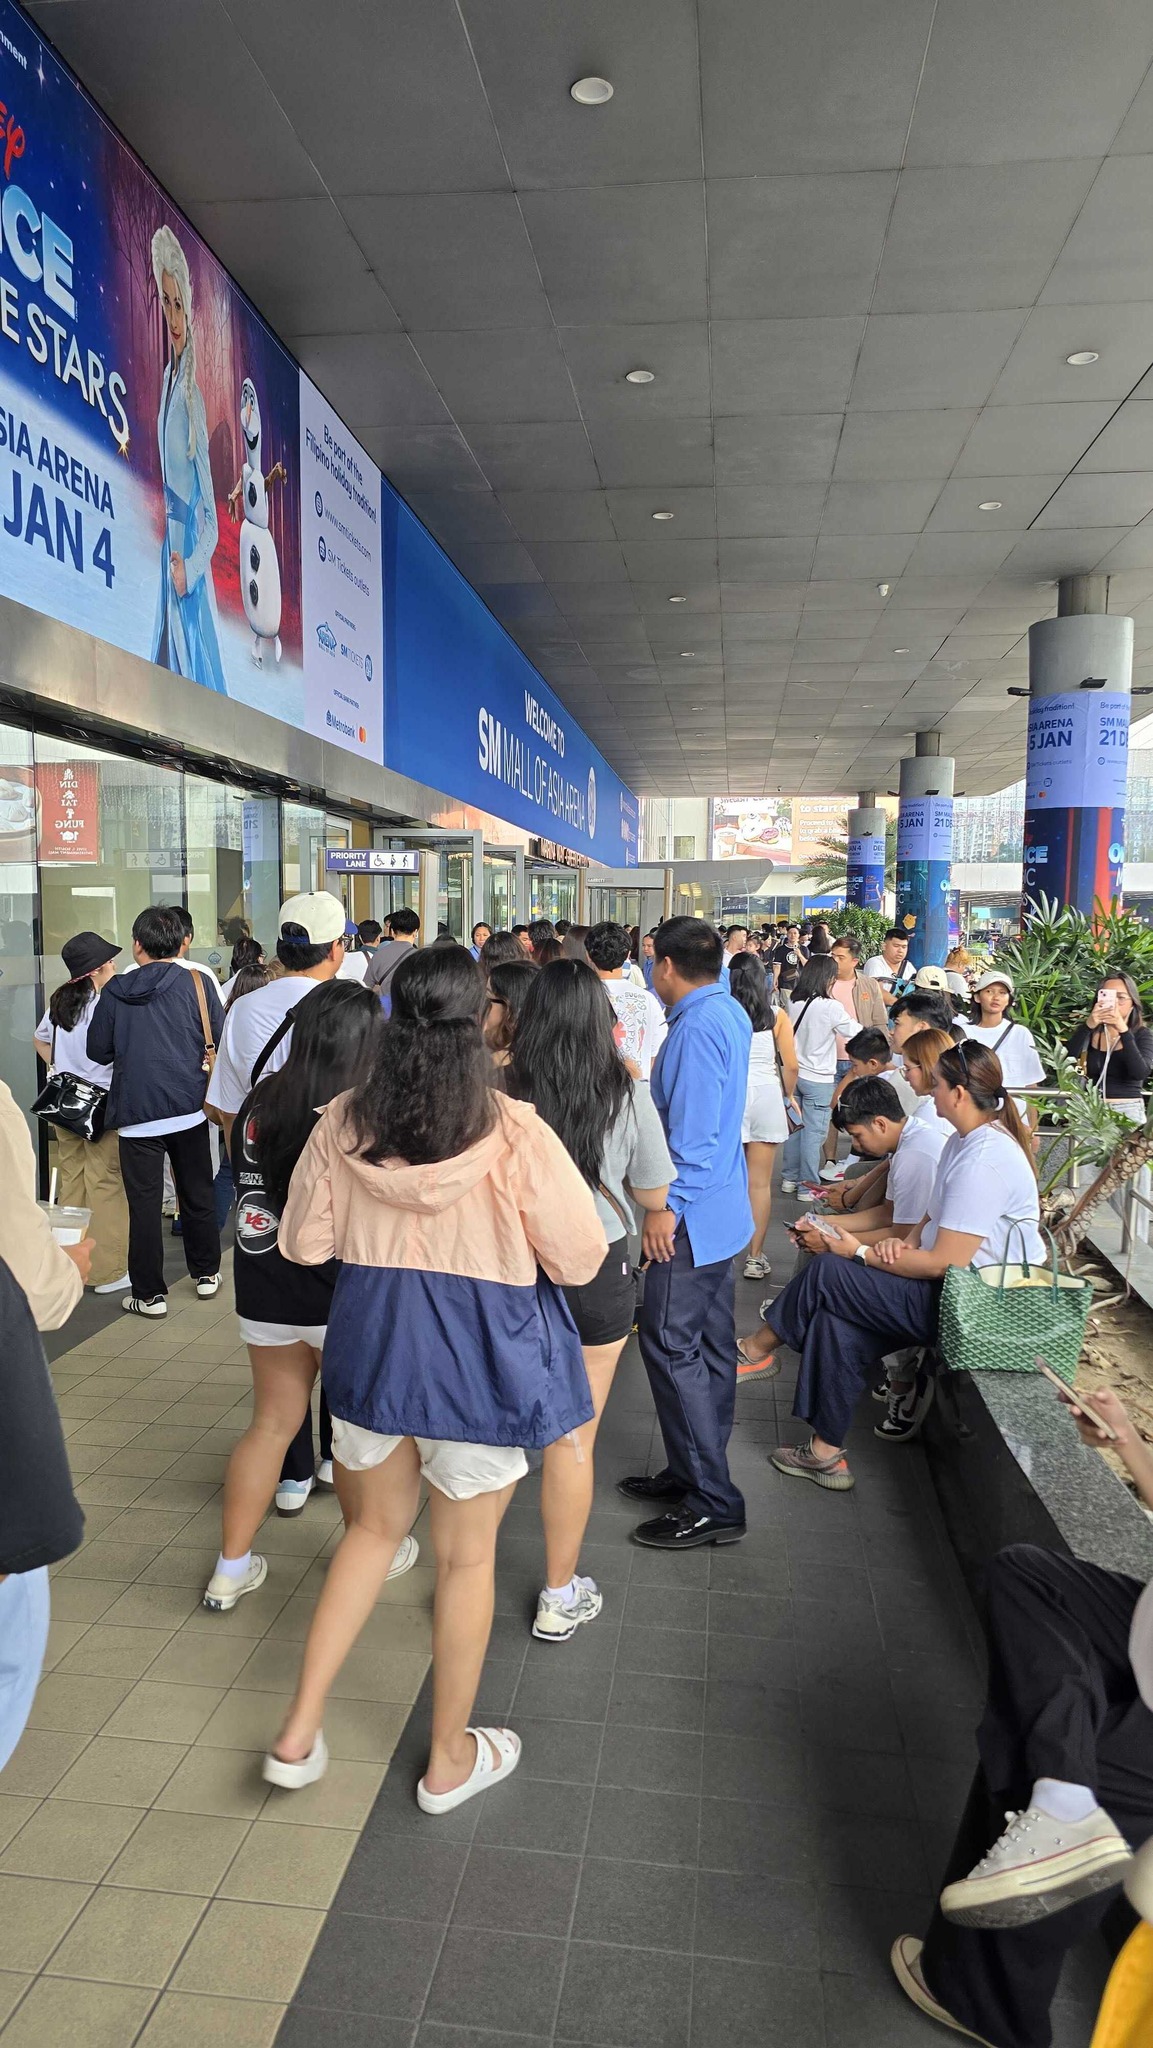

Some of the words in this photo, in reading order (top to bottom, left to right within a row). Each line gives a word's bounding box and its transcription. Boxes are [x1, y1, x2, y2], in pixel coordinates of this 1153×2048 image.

[27, 302, 128, 446] STARS
[324, 423, 333, 450] Be
[334, 440, 346, 465] part
[346, 456, 354, 473] of
[354, 462, 363, 486] the
[37, 436, 115, 520] ARENA
[306, 426, 330, 470] Filipino
[330, 456, 352, 500] holiday
[352, 483, 377, 524] tradition!
[3, 469, 84, 574] JAN
[92, 527, 115, 589] 4
[324, 507, 372, 563] www.smtickets.com
[328, 548, 336, 567] SM
[336, 555, 354, 582] Tickets
[354, 575, 370, 597] outlets
[1044, 703, 1074, 713] tradition!
[332, 714, 356, 738] Metrobank
[524, 689, 556, 751] WELCOME
[557, 726, 565, 758] TO
[1038, 718, 1074, 732] ARENA
[1100, 717, 1114, 726] SM
[1038, 730, 1072, 750] JAN
[1099, 730, 1116, 746] 21
[478, 707, 501, 780] SM
[503, 727, 534, 801] MALL
[534, 755, 547, 806] OF
[548, 766, 565, 820] ASIA
[565, 782, 586, 832] ARENA
[812, 804, 839, 812] start
[905, 818, 924, 828] JAN
[934, 818, 944, 827] 21
[245, 1212, 270, 1232] KC
